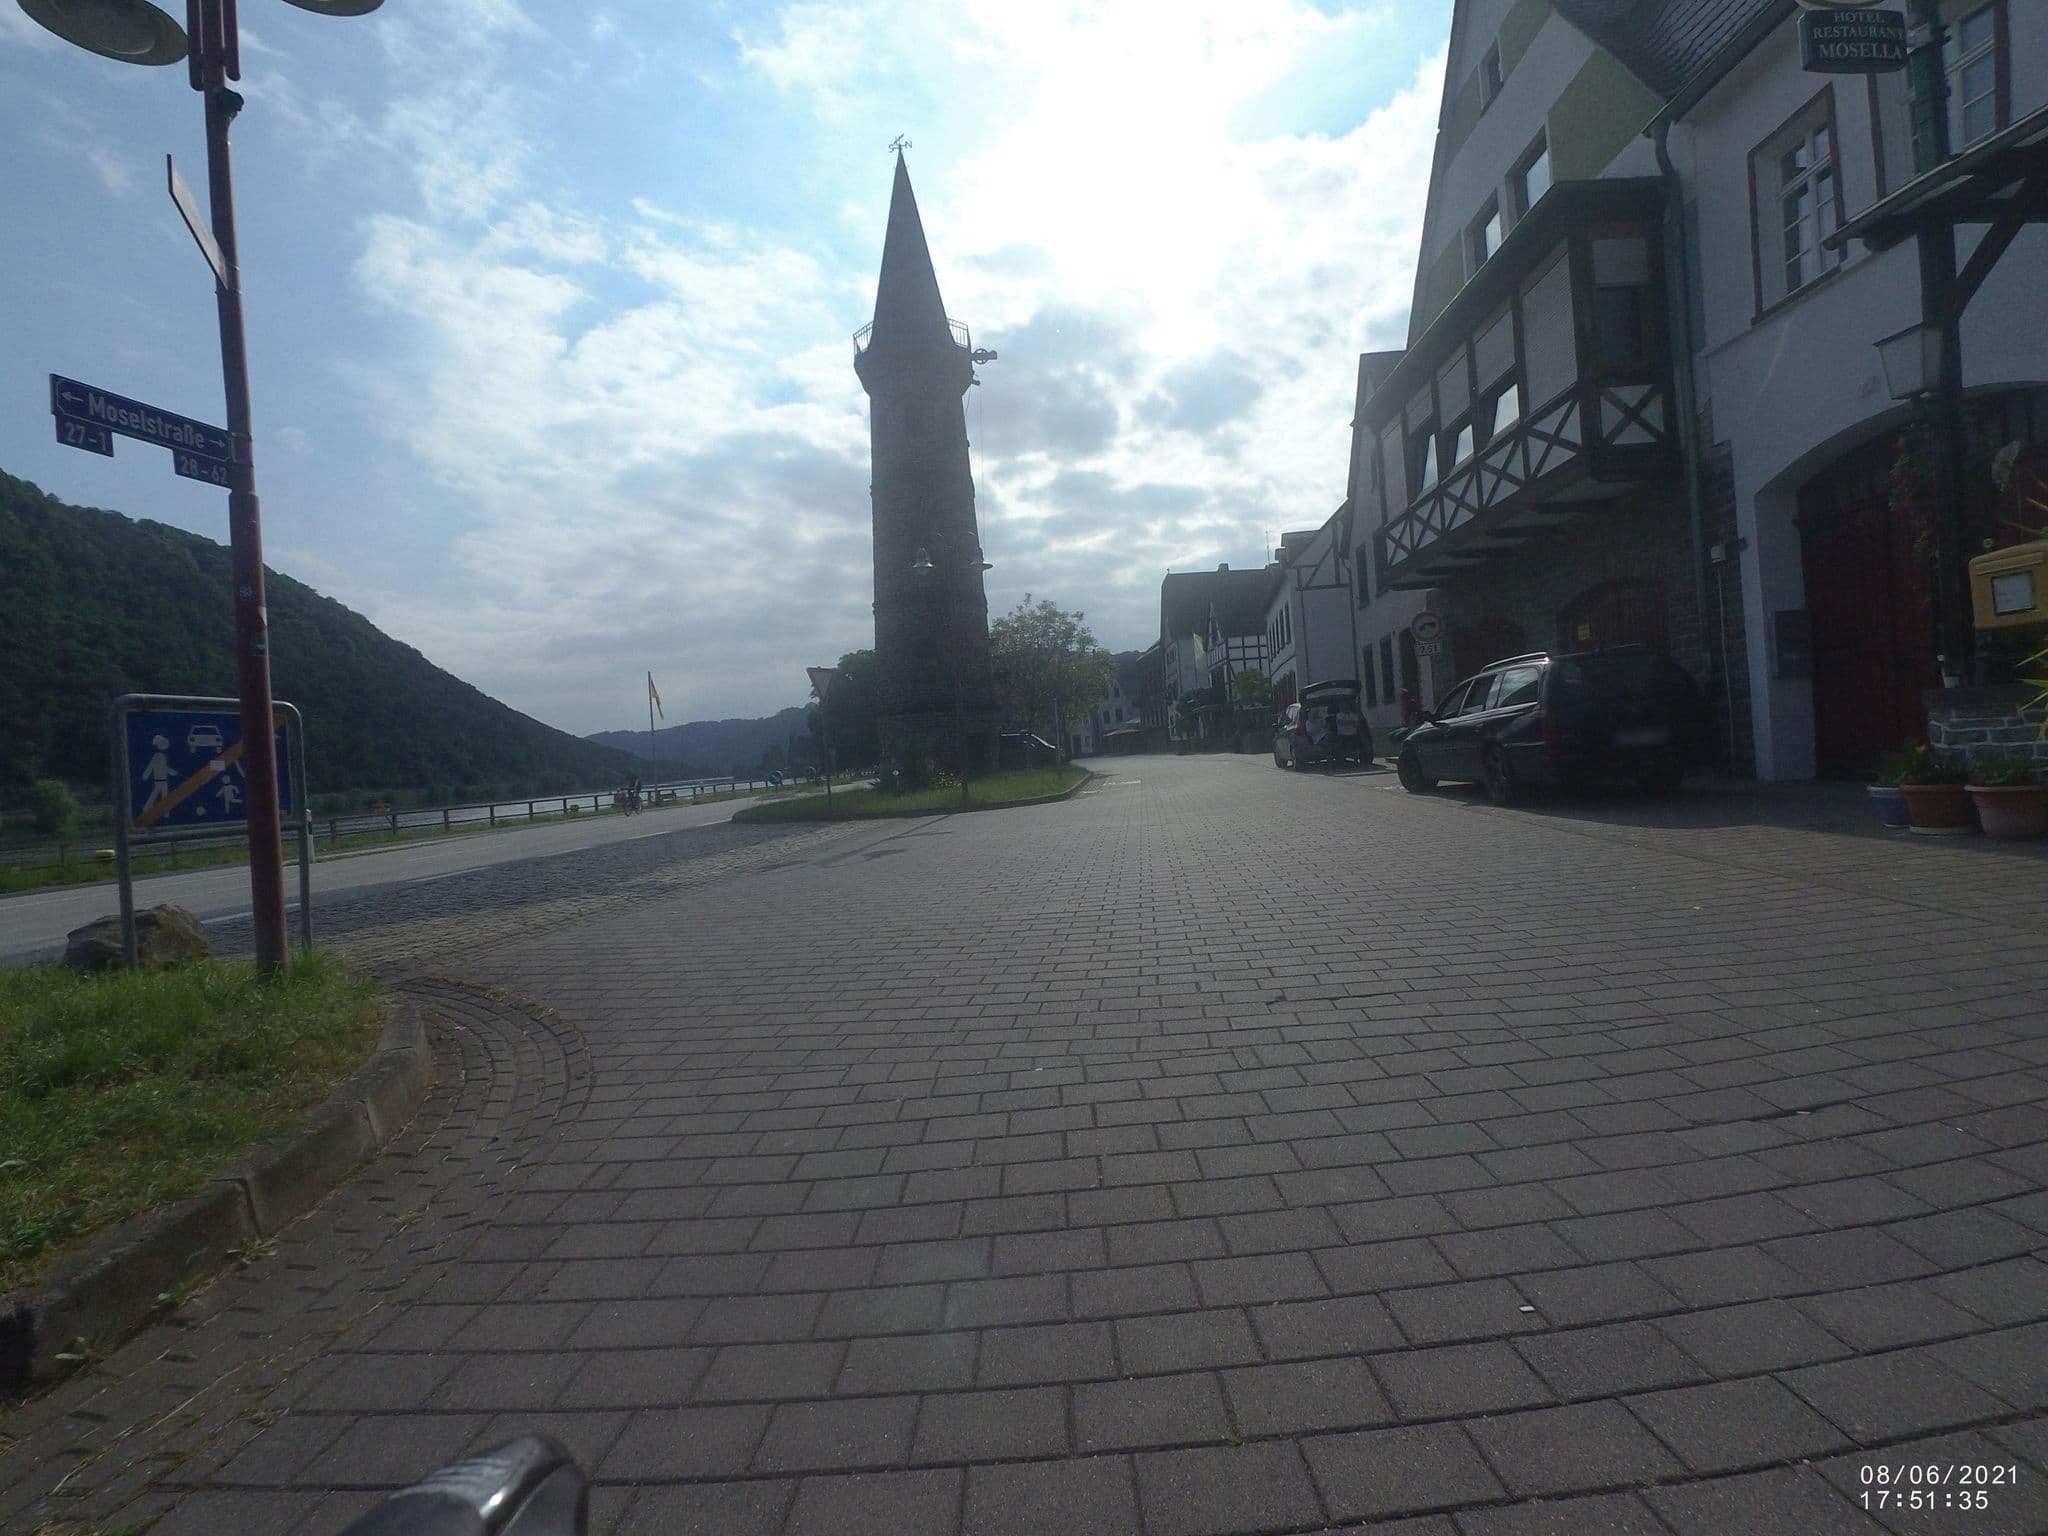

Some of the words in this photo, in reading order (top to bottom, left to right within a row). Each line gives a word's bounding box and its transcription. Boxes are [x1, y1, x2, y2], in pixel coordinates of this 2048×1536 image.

[1834, 11, 1885, 23] HOTEL
[1813, 26, 1903, 40] RESTAURANT
[1820, 43, 1902, 59] MOSELLA
[87, 392, 205, 450] Moselstraße
